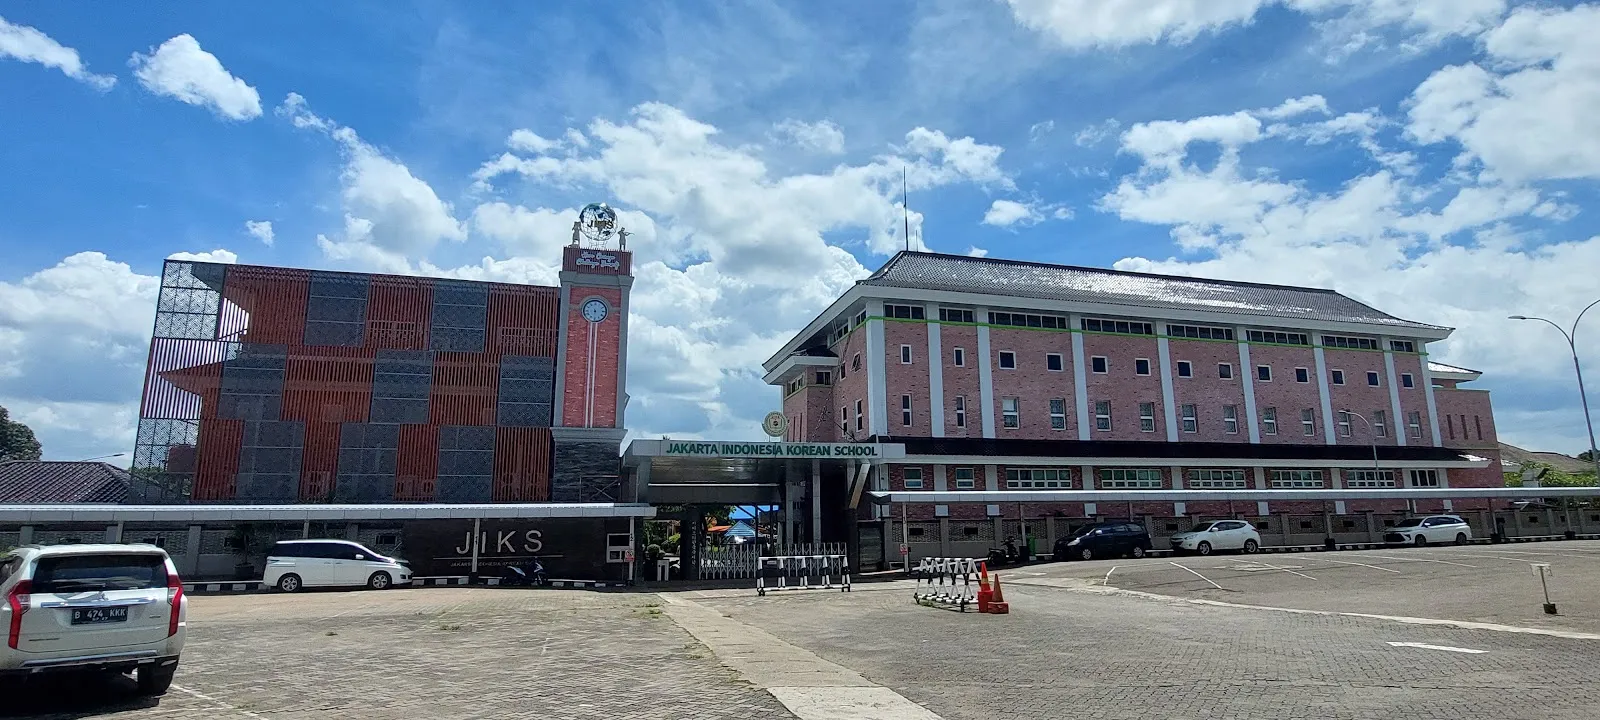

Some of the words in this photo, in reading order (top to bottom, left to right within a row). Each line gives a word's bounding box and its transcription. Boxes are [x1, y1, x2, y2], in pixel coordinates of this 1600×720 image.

[666, 442, 718, 455] JAKARTA
[722, 443, 783, 456] INDONESIA
[786, 445, 831, 456] KOREAN
[834, 445, 878, 457] SCHOOL
[456, 530, 543, 554] JIKS
[74, 611, 81, 619] B
[87, 609, 104, 618] 474
[109, 608, 126, 617] KKK
